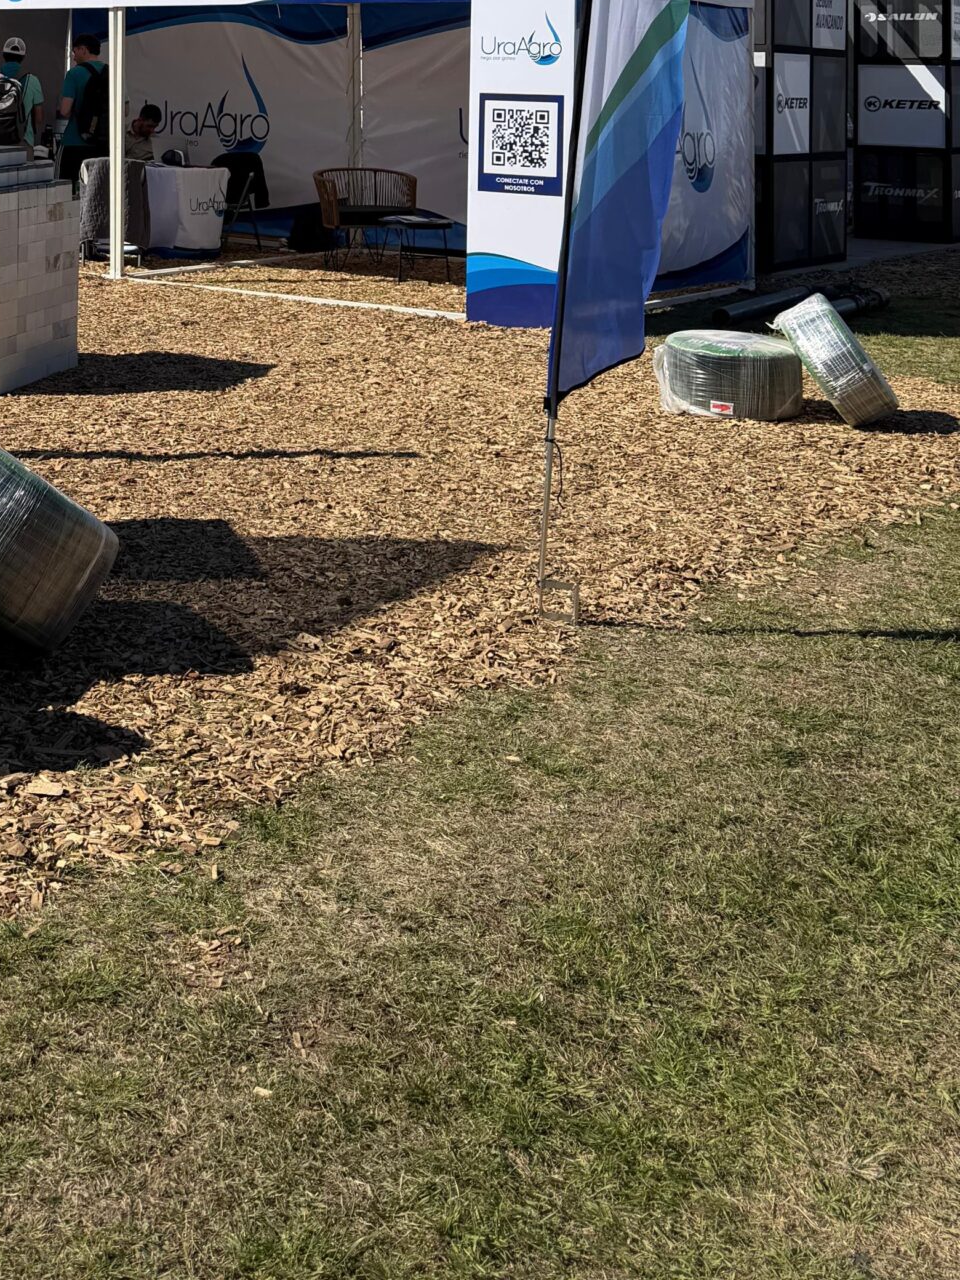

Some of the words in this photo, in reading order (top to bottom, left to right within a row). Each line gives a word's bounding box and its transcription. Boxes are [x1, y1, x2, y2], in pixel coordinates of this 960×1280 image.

[877, 12, 938, 21] SAILUN
[481, 36, 563, 61] UraAgro
[783, 97, 808, 110] KETER
[882, 99, 940, 110] KETER
[496, 177, 529, 185] CONECTATE
[504, 184, 535, 193] NOSOTROS
